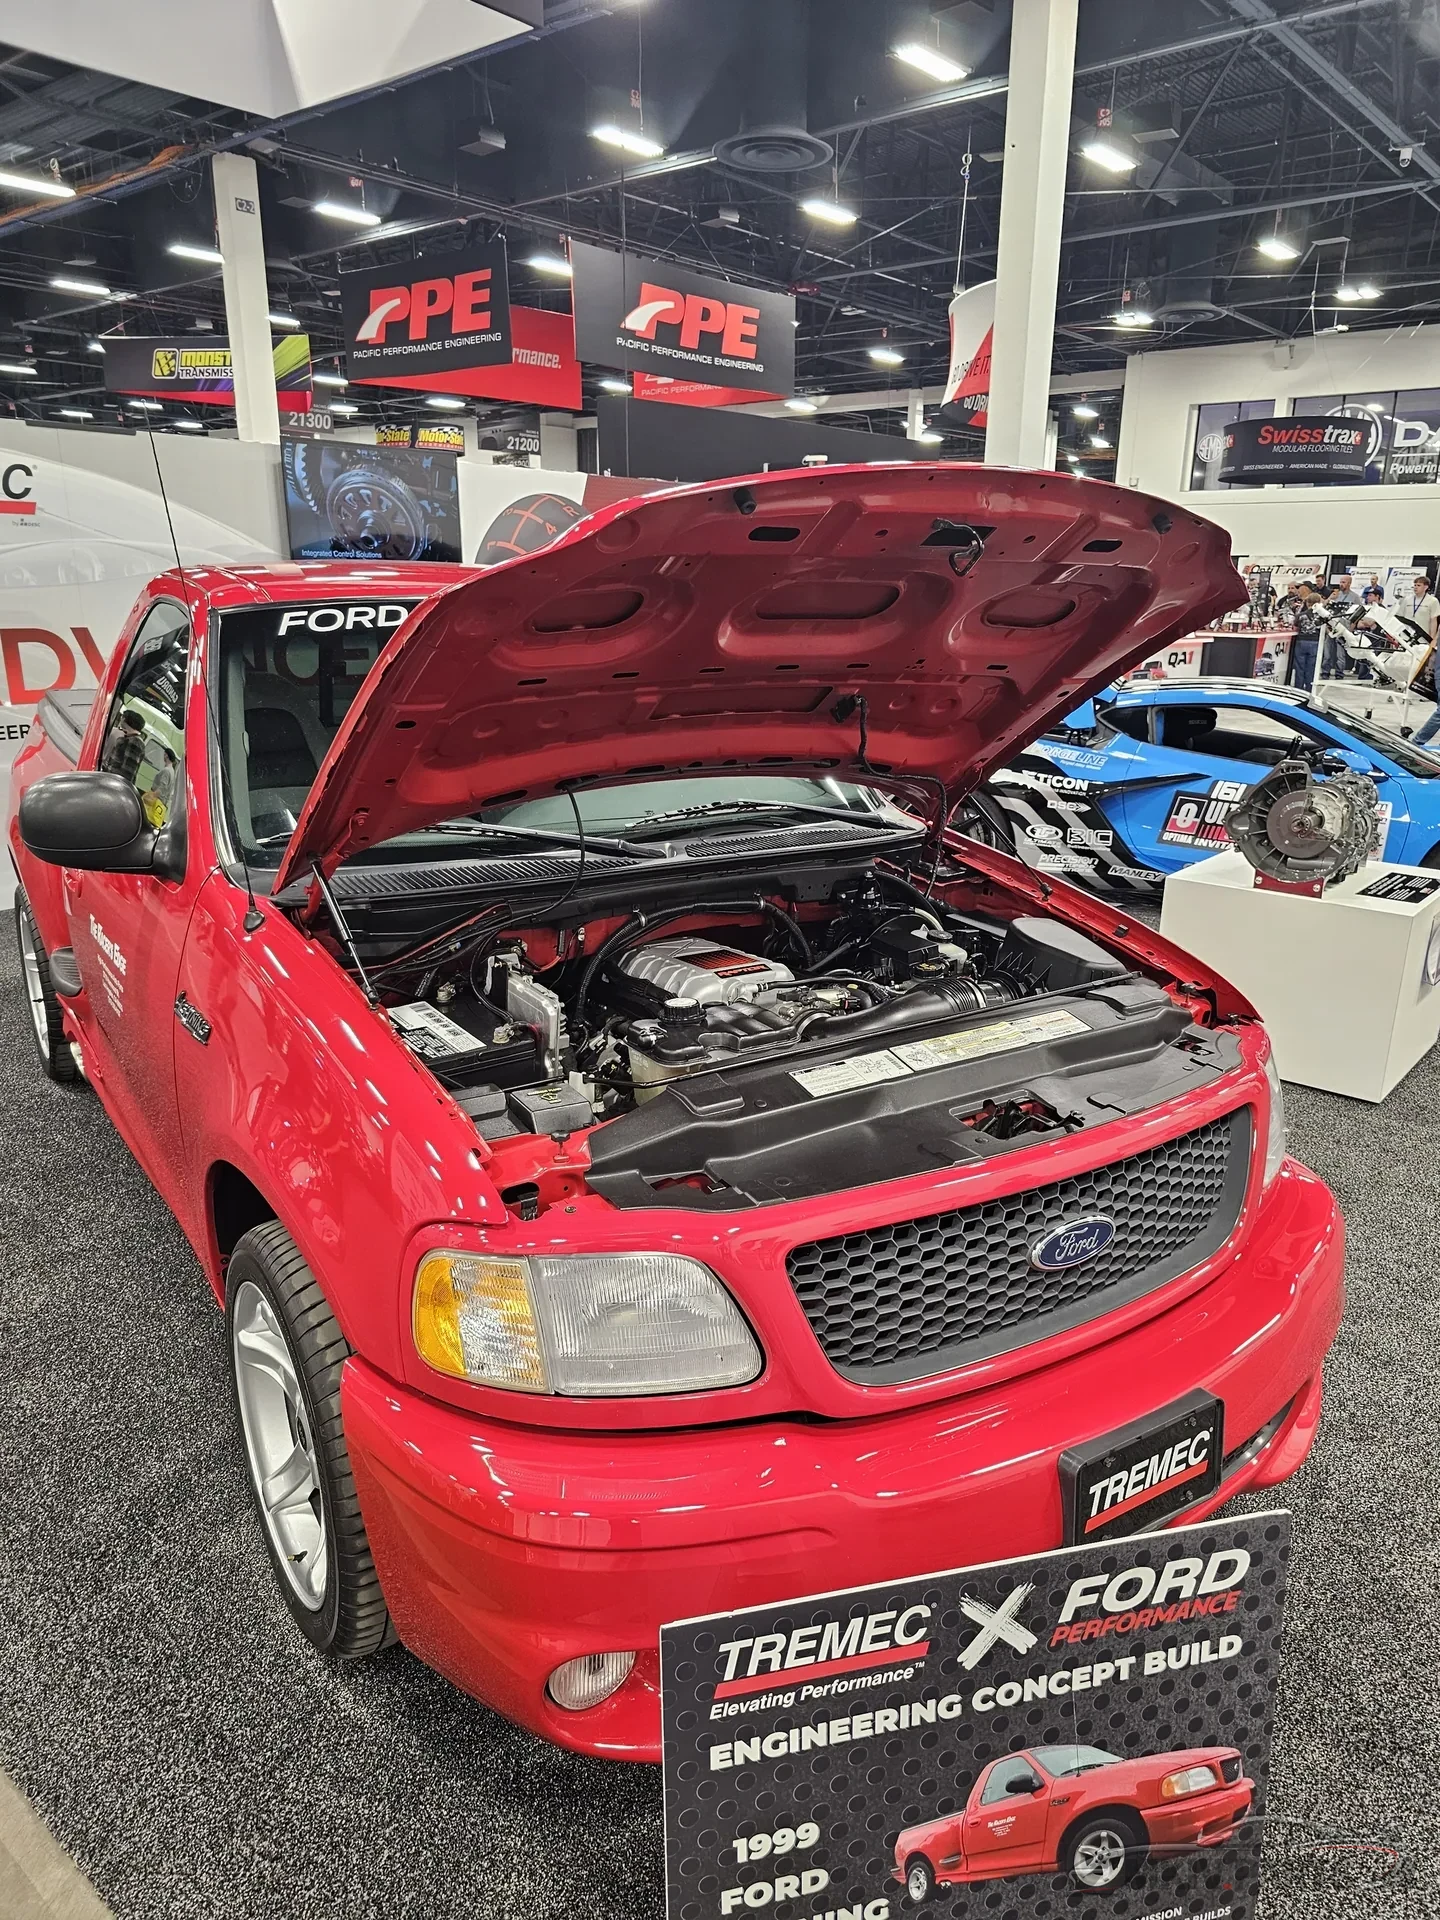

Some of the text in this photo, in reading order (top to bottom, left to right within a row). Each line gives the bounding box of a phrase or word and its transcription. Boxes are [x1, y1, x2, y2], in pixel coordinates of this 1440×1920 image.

[355, 268, 492, 345] PPE
[620, 282, 760, 359] PPE
[353, 332, 501, 359] PACIFIC PERFORMANCE ENGINEERING
[616, 337, 764, 372] PACIFIC PERFORMANCE ENGINEERING
[641, 387, 669, 396] PACIFIC
[289, 411, 331, 430] 21300
[507, 436, 539, 452] 21200
[1258, 424, 1356, 445] Swisstrax
[1272, 445, 1353, 454] MODULAR FLOORING TILES
[545, 522, 558, 536] 4
[302, 549, 382, 558] Integrated Control Solutions
[278, 605, 409, 636] FORD
[1168, 651, 1194, 668] QA1
[1033, 742, 1108, 766] FORGELINE
[1210, 780, 1247, 802] 161
[1162, 831, 1192, 845] OPTIMA
[1038, 853, 1099, 866] PRECISION
[1110, 866, 1162, 881] MANLEY
[1055, 1227, 1099, 1261] Ford
[1089, 1429, 1210, 1517] TREMEC
[717, 1605, 931, 1681] TREMEC
[1058, 1548, 1251, 1624] FORD
[1051, 1590, 1242, 1647] PERFORMANCE
[709, 1633, 1242, 1772] ENGINEERING CONCEPT BUILD
[710, 1688, 796, 1720] Elevating
[732, 1821, 821, 1864] 1999
[721, 1868, 830, 1915] FORD
